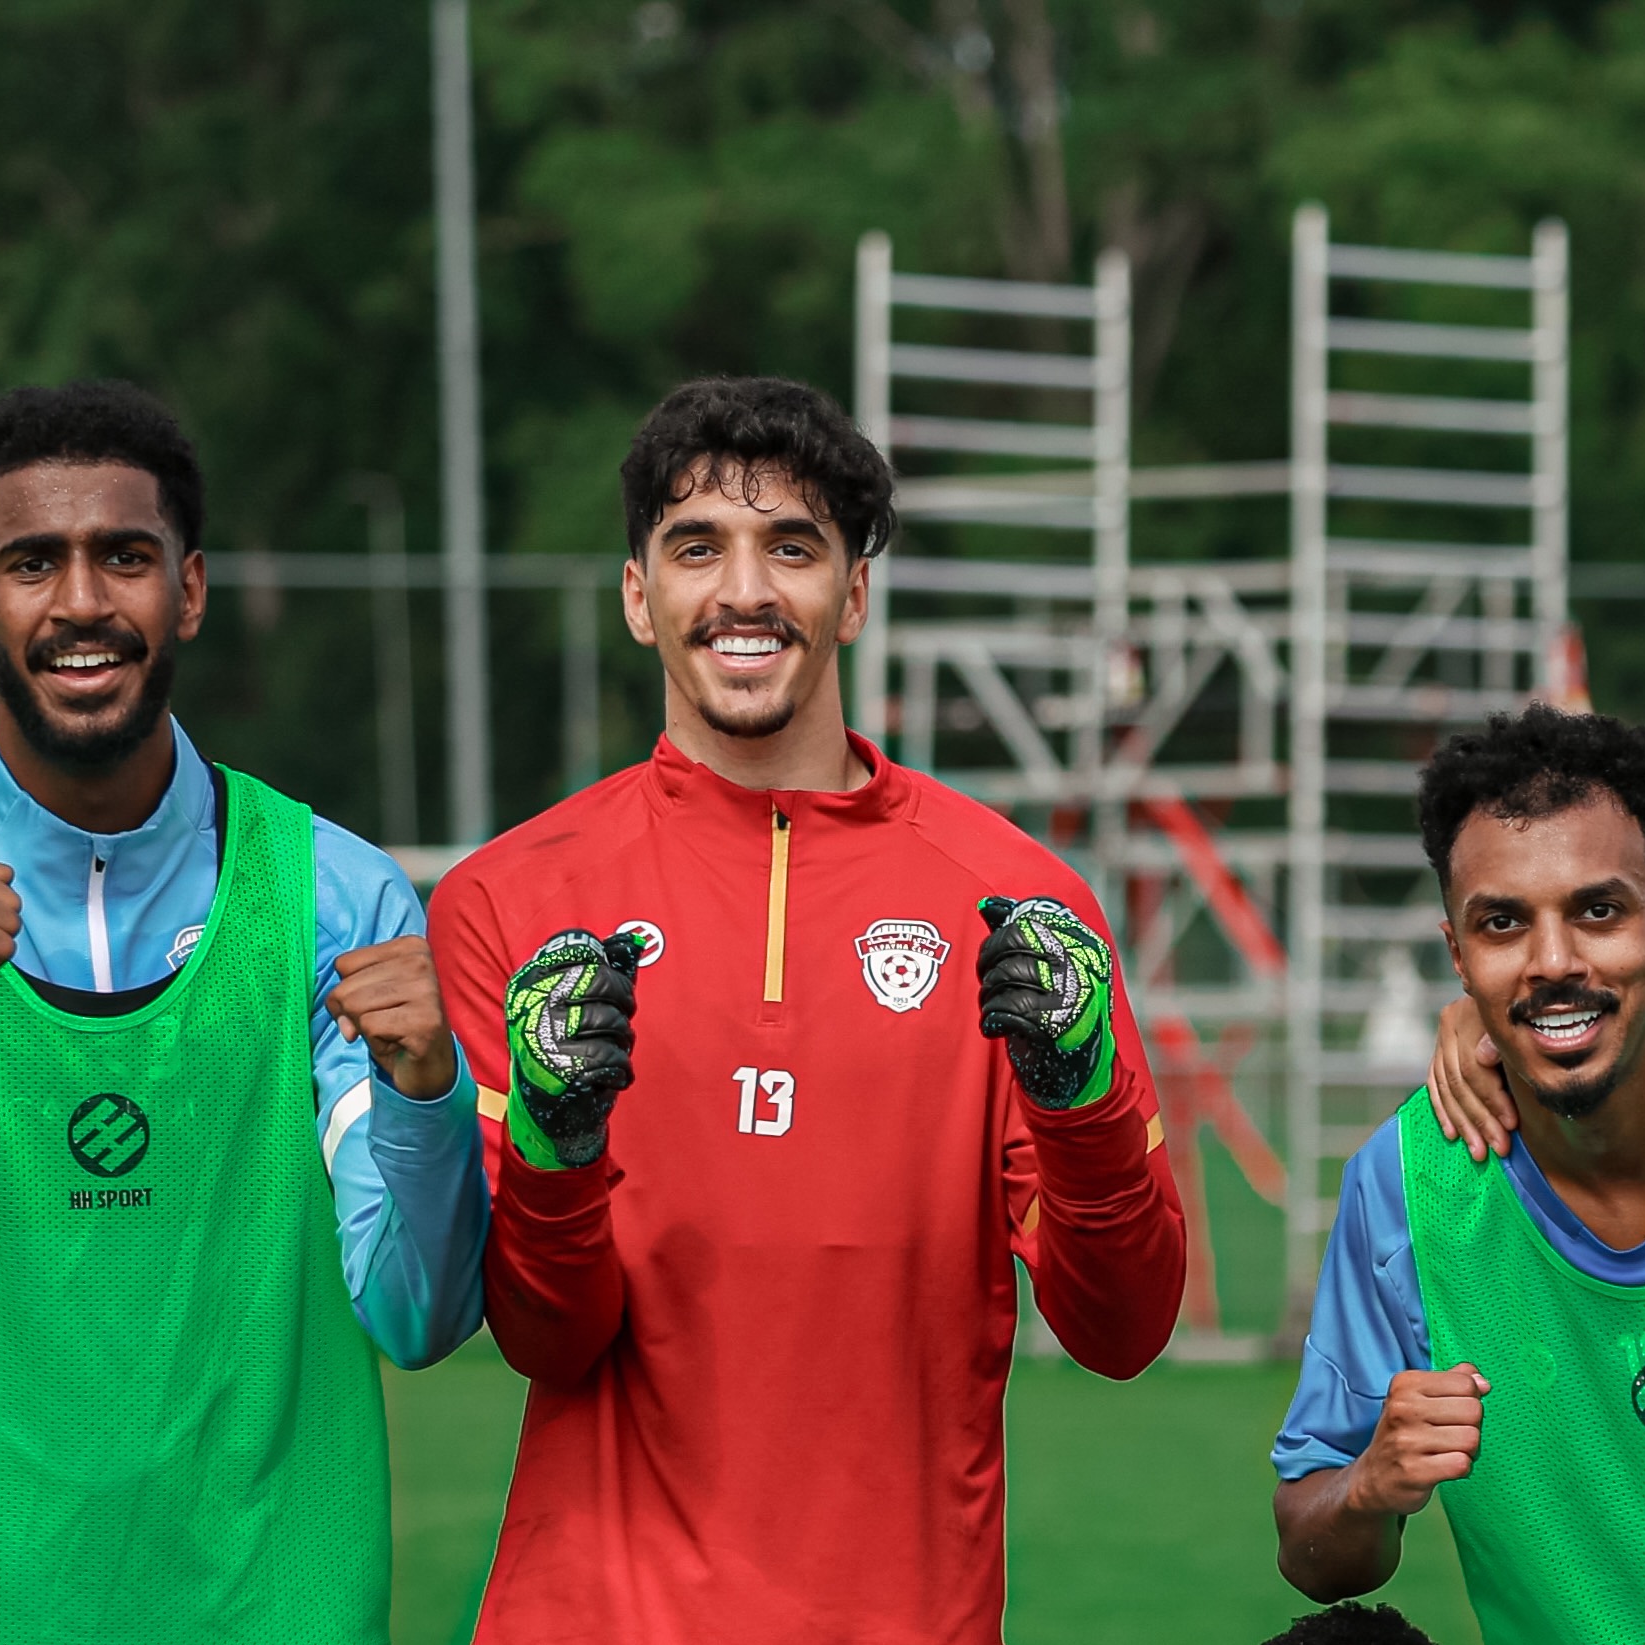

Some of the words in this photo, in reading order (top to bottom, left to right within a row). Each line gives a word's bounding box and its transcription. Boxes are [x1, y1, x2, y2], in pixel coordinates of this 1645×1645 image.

[731, 1066, 796, 1137] 13
[70, 1190, 93, 1210] HH
[97, 1188, 153, 1210] SPORT
